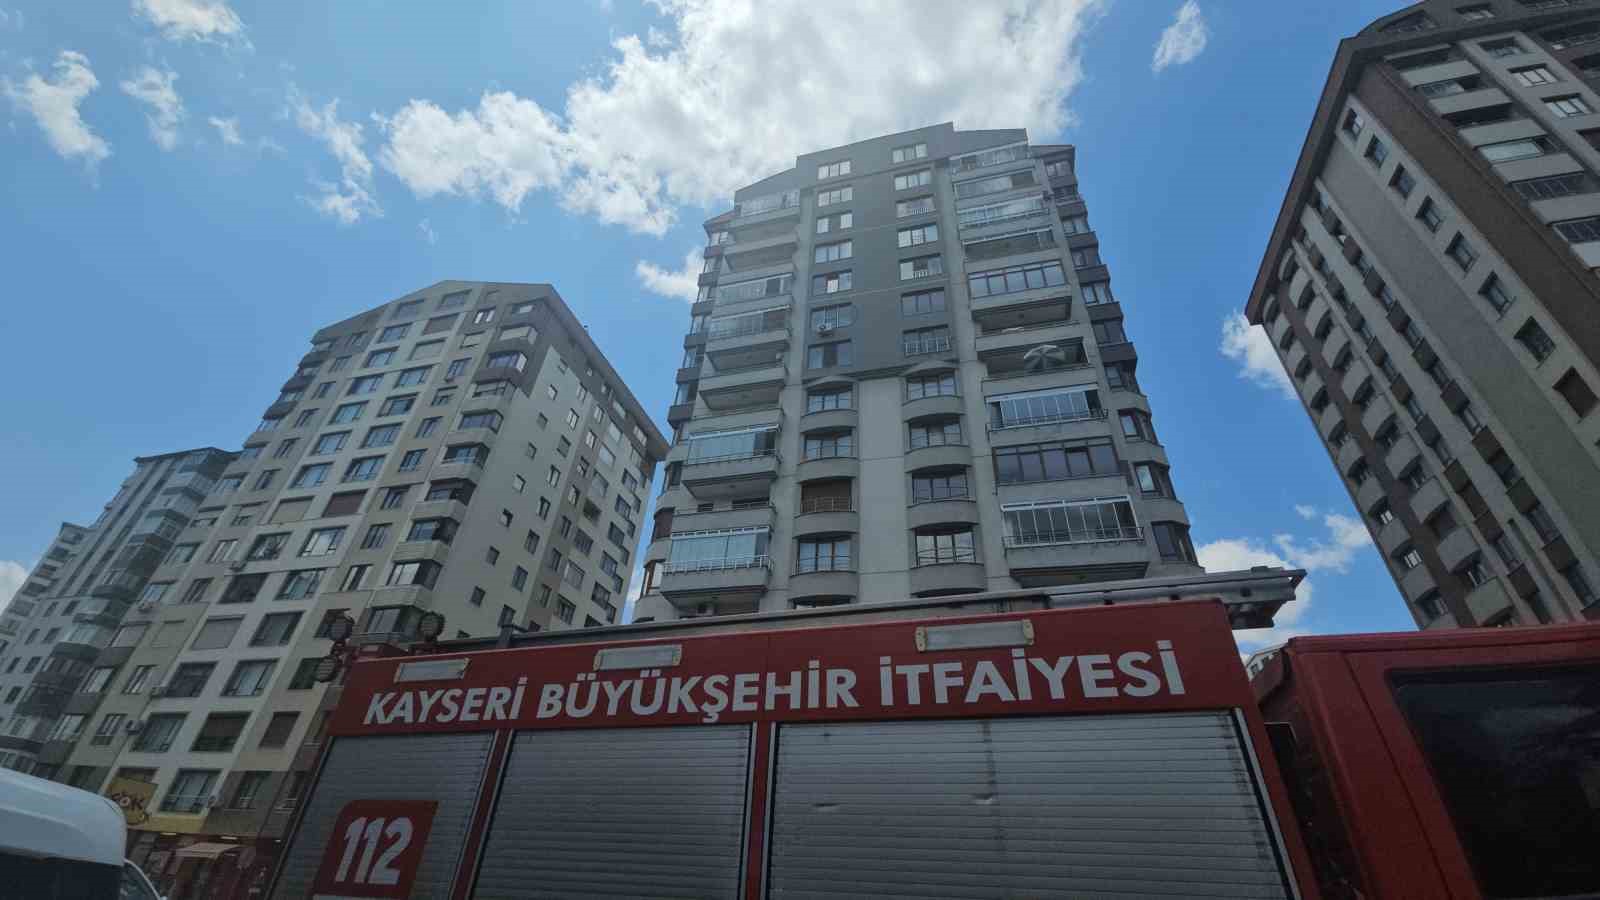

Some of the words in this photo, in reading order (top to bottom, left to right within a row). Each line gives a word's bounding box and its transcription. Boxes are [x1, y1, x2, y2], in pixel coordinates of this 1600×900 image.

[364, 677, 528, 724] KAYSERİ
[535, 660, 859, 722] BÜYÜKŞEHİR
[880, 640, 1185, 705] İTFAİYESİ
[335, 816, 413, 885] 112
